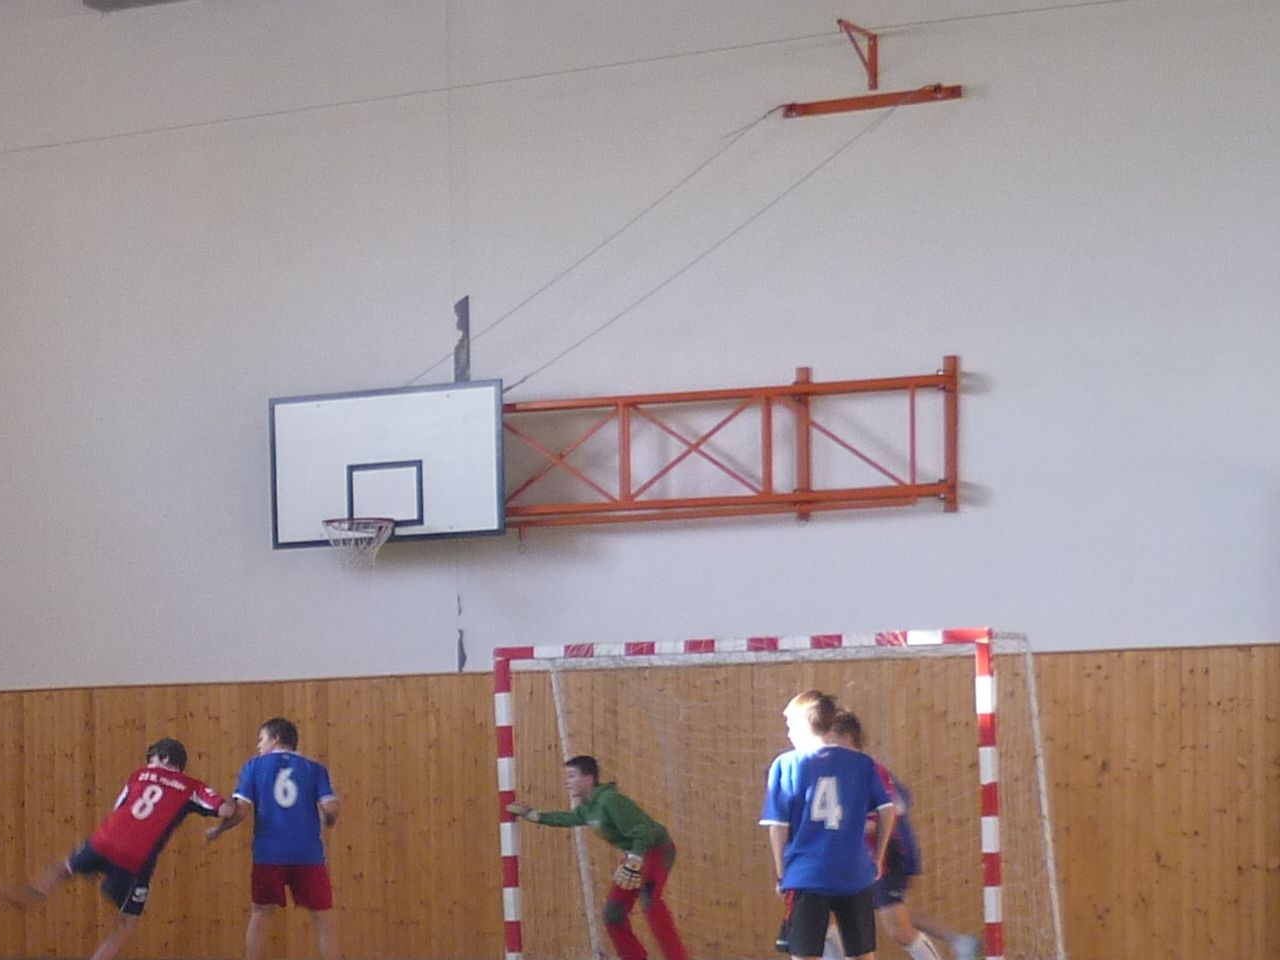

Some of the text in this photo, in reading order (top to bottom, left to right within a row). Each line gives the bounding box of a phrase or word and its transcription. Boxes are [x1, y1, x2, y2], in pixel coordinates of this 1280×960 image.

[131, 785, 163, 820] 8
[274, 768, 298, 808] 6
[810, 776, 842, 830] 4
